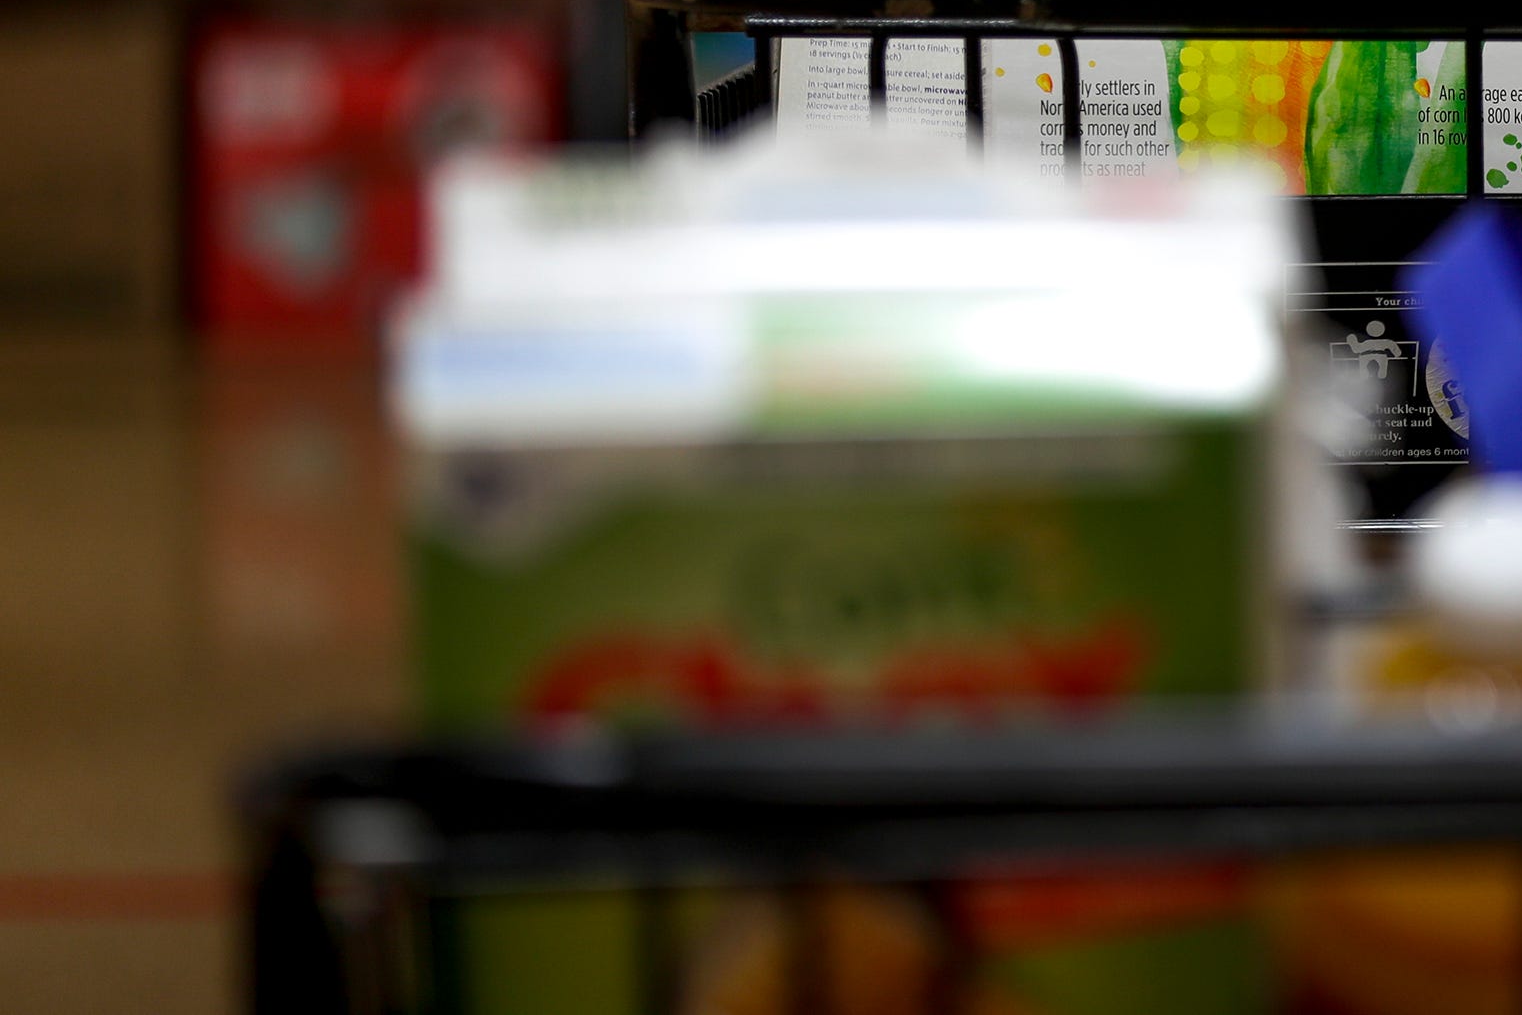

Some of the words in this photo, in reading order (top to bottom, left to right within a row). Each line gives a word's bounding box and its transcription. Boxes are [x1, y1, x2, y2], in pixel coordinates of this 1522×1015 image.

[810, 39, 828, 47] Prep
[830, 39, 850, 48] Time:
[897, 43, 916, 51] Start
[918, 44, 926, 52] to
[819, 51, 851, 60] servings
[808, 65, 824, 73] Into
[826, 65, 845, 75] large
[1095, 80, 1140, 95] settlers
[1144, 80, 1155, 95] in
[1439, 85, 1455, 101] An
[1459, 88, 1507, 103] arage
[836, 92, 860, 100] butter
[904, 96, 945, 105] uncovered
[849, 103, 871, 111] abou
[888, 106, 916, 114] econds
[1040, 100, 1063, 116] Nor
[1079, 100, 1129, 116] America
[1132, 100, 1162, 116] used
[1418, 107, 1430, 122] of
[1434, 110, 1460, 123] corn
[1487, 107, 1511, 124] 800
[1088, 123, 1130, 138] money
[1133, 121, 1157, 136] and
[1418, 129, 1429, 145] in
[1433, 129, 1445, 145] 16
[1085, 140, 1102, 156] for
[1105, 140, 1133, 156] such
[1136, 140, 1170, 156] other
[1097, 164, 1110, 176] as
[1113, 162, 1146, 176] meat
[1375, 297, 1401, 306] Your
[1376, 404, 1435, 417] buckle-up
[1410, 417, 1433, 427] and
[1407, 449, 1431, 458] ages
[1434, 448, 1441, 456] 6
